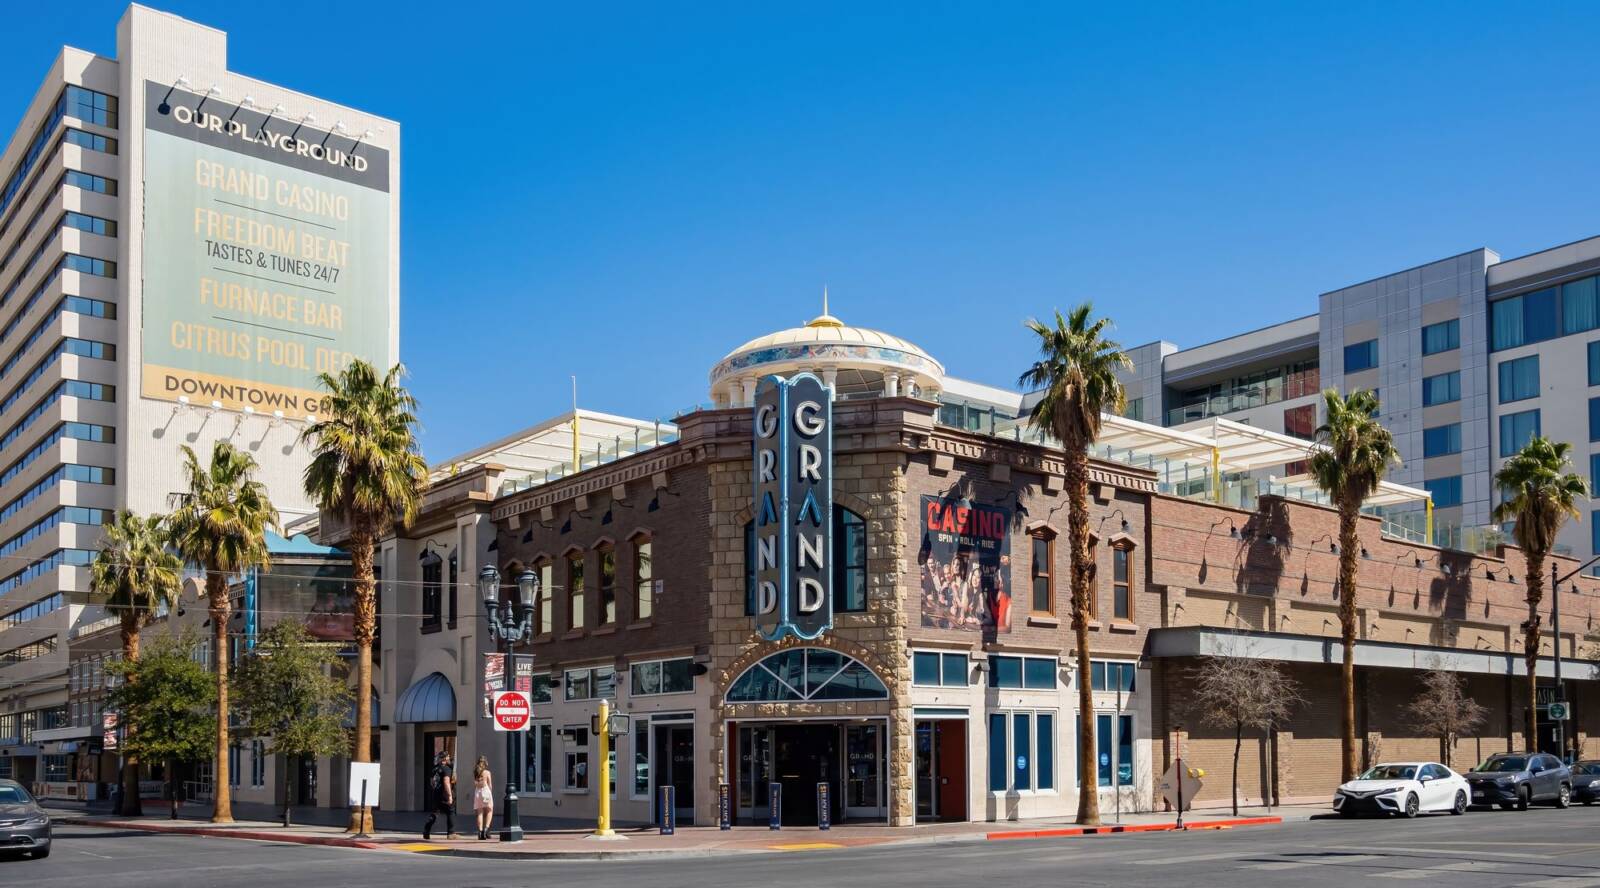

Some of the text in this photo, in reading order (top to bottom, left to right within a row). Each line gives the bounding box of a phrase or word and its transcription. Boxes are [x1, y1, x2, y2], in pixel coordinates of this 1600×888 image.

[174, 105, 368, 172] OUR PLAYGROUND
[195, 159, 349, 221] GRAND CASINO
[194, 207, 350, 266] FREEDOM BEAT
[205, 240, 340, 284] TASTES & TUNES 24/7
[200, 277, 343, 331] FURNACE BAR
[171, 320, 353, 378] CITRUS POOL DEC
[165, 375, 297, 409] DOWNTOWN
[756, 404, 777, 616] GRAND
[794, 400, 826, 613] GRAND
[927, 501, 1005, 539] CASINO
[938, 533, 995, 549] SPIN ROLL RIDE
[499, 699, 524, 707] DO NOT
[502, 715, 523, 723] ENTER
[1536, 688, 1556, 705] ASIN
